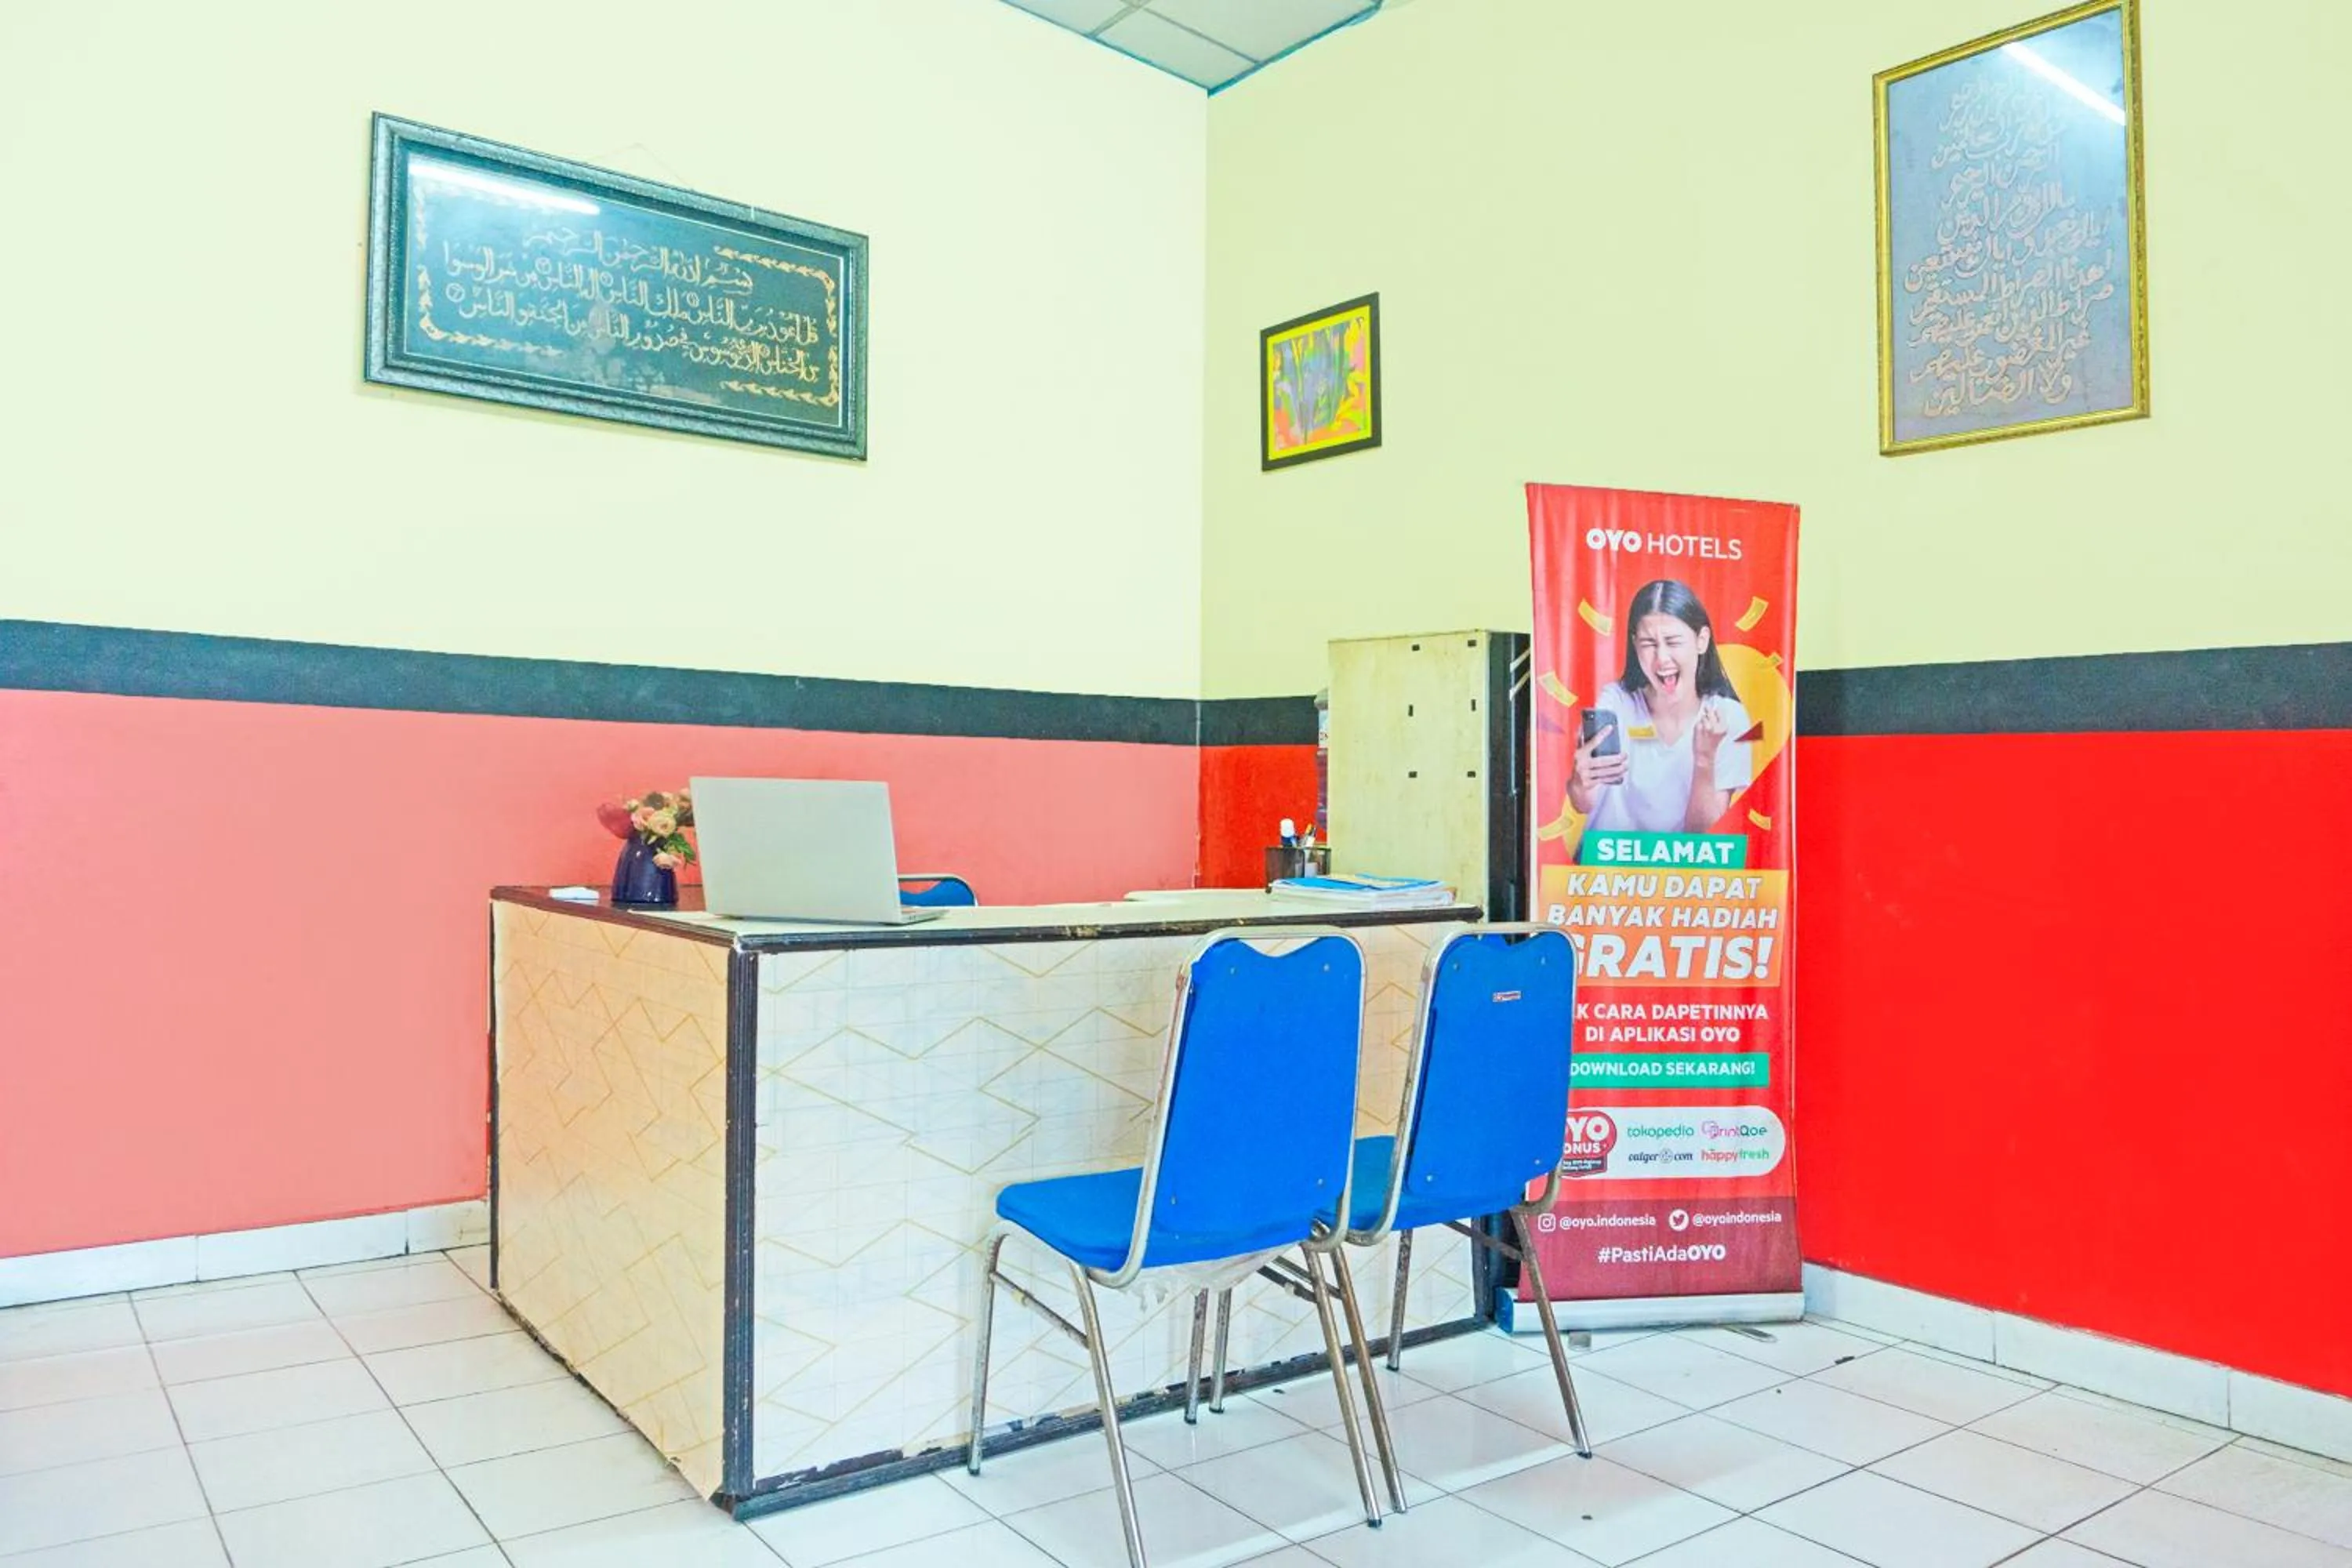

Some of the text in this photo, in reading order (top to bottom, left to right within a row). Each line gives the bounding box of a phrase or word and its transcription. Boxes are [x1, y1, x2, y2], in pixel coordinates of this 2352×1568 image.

[1586, 528, 1742, 560] OYO HOTELS
[1597, 838, 1735, 864] SELAMAT
[1567, 873, 1762, 899] KAMU DAPAT
[1547, 904, 1779, 929] BANYAK HADIAH
[1593, 1004, 1647, 1019] CARA
[1652, 1004, 1769, 1020] DAPETINNYA
[1585, 1026, 1741, 1043] DI APLIKASI OYO
[1570, 1062, 1757, 1076] DOWNLOAD SEKARANG!
[1566, 1116, 1610, 1142] YO
[1626, 1123, 1695, 1139] tokopedia
[1563, 1142, 1600, 1154] ONUS
[1559, 1209, 1783, 1232] @oyo.indonesia @oyoindonesia
[1597, 1243, 1726, 1264] #PastiAdaOYO
